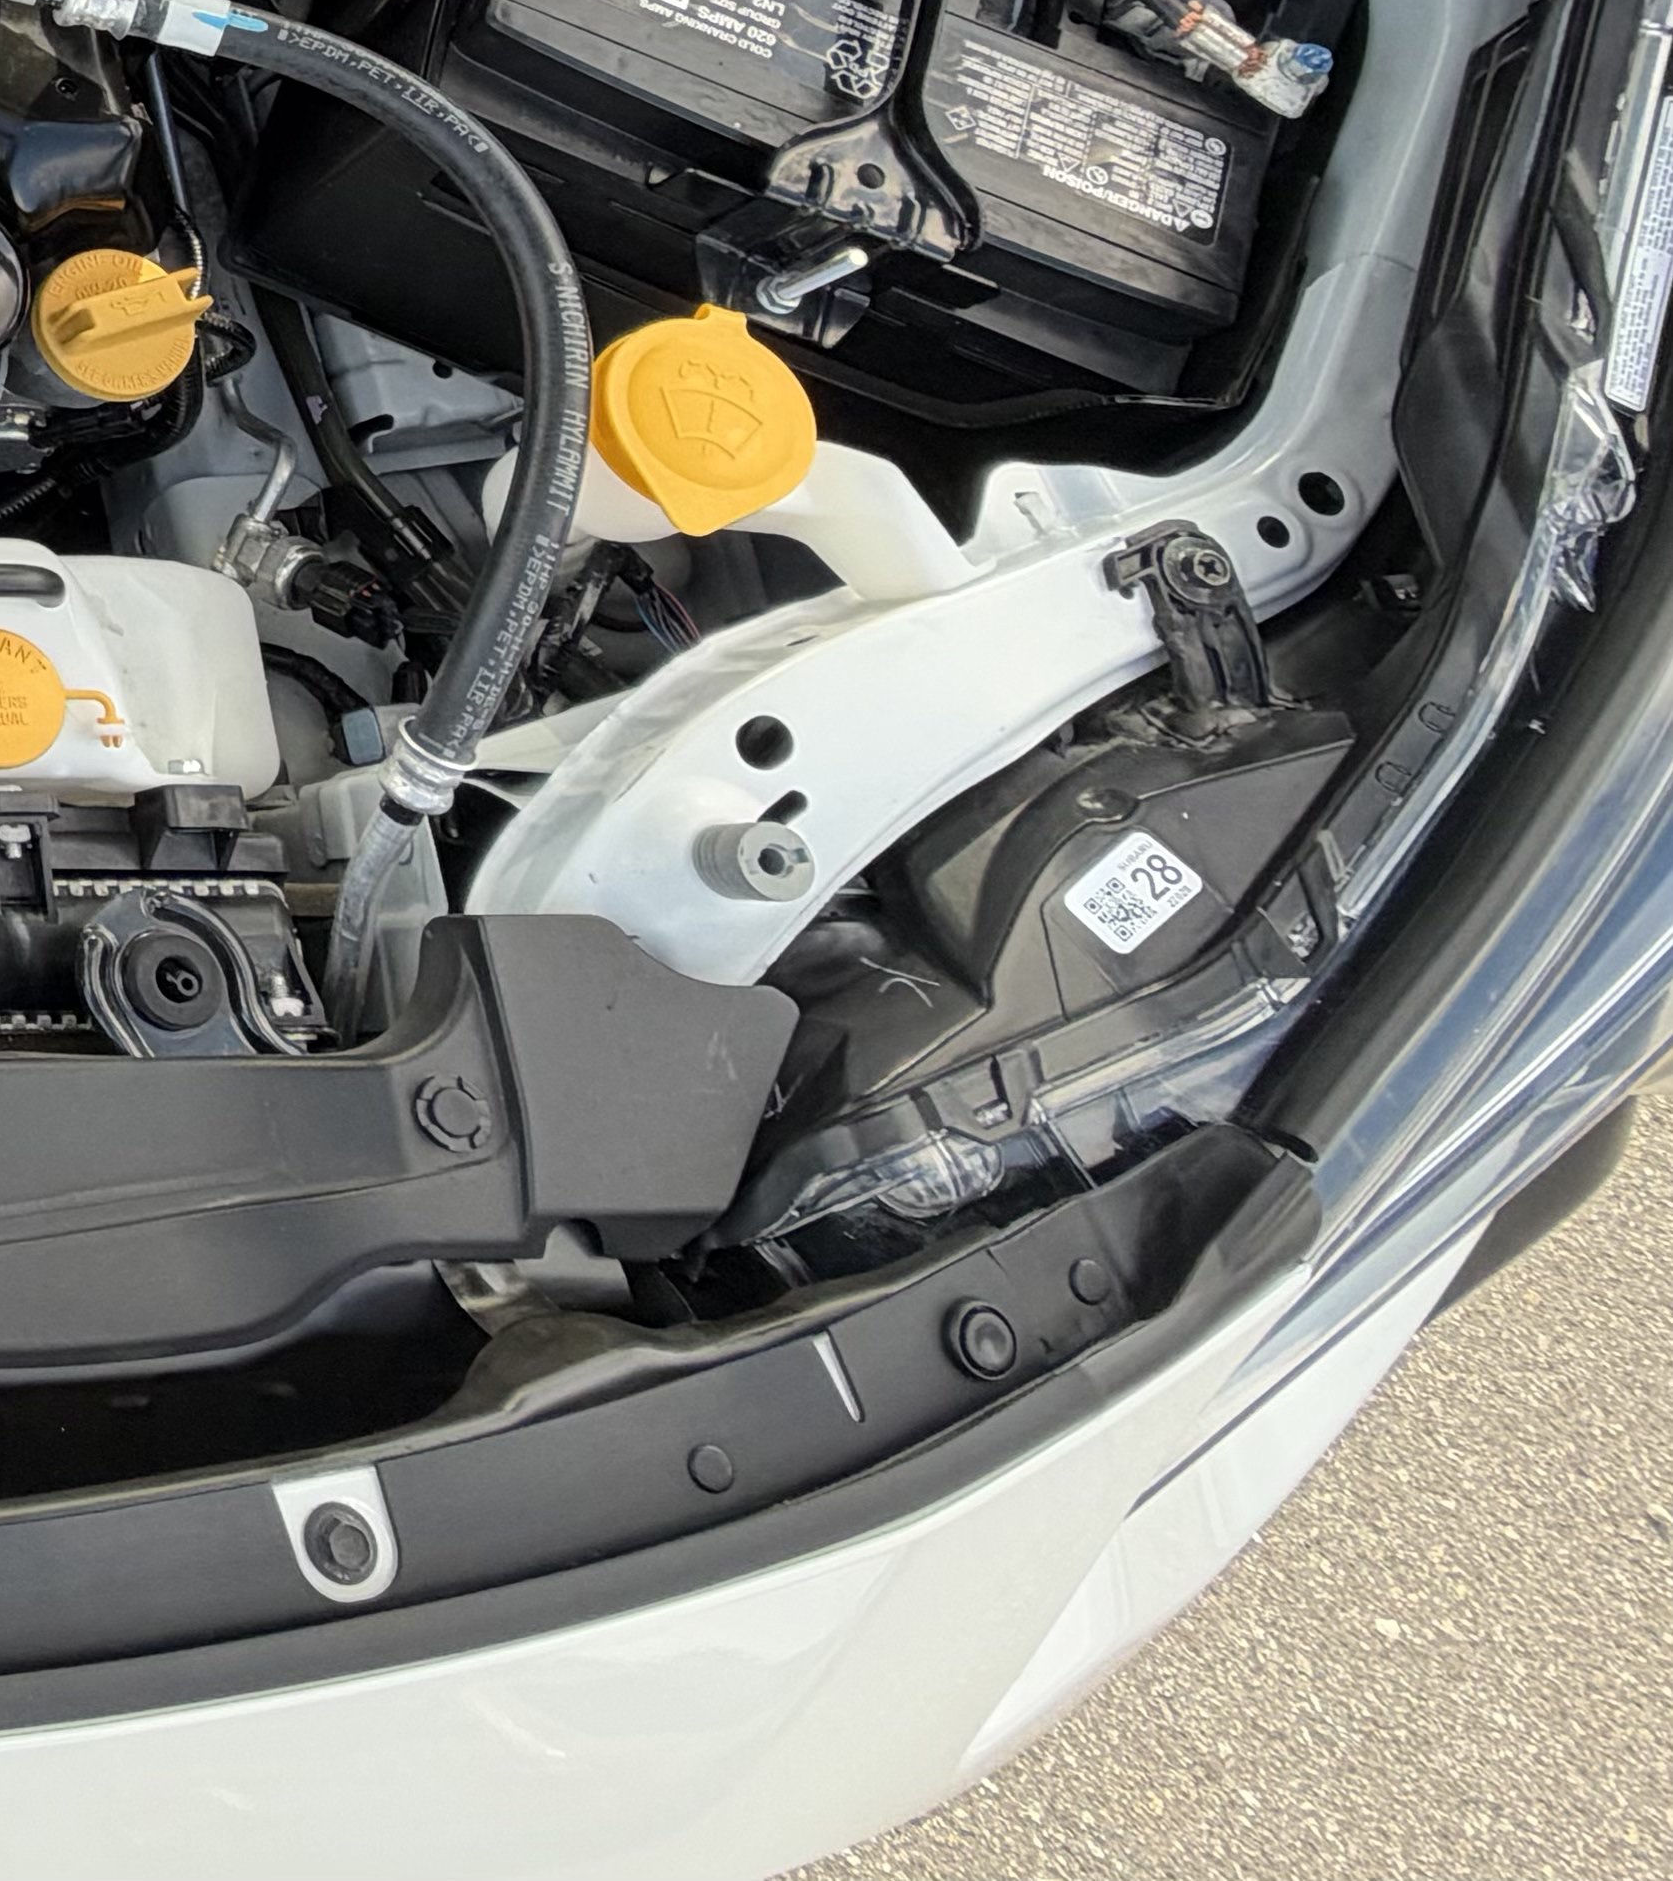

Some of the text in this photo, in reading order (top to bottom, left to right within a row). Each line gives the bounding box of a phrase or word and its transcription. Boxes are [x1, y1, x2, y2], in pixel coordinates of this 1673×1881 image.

[674, 11, 738, 46] CRANKING
[696, 5, 778, 46] 620 AMPS
[737, 4, 782, 29] GROUP
[737, 36, 773, 59] COLD
[1042, 164, 1175, 228] DANGER/POISON
[50, 255, 143, 297] ENGINE OIL
[546, 409, 587, 517] HYLAMMIT
[1130, 854, 1183, 901] 28
